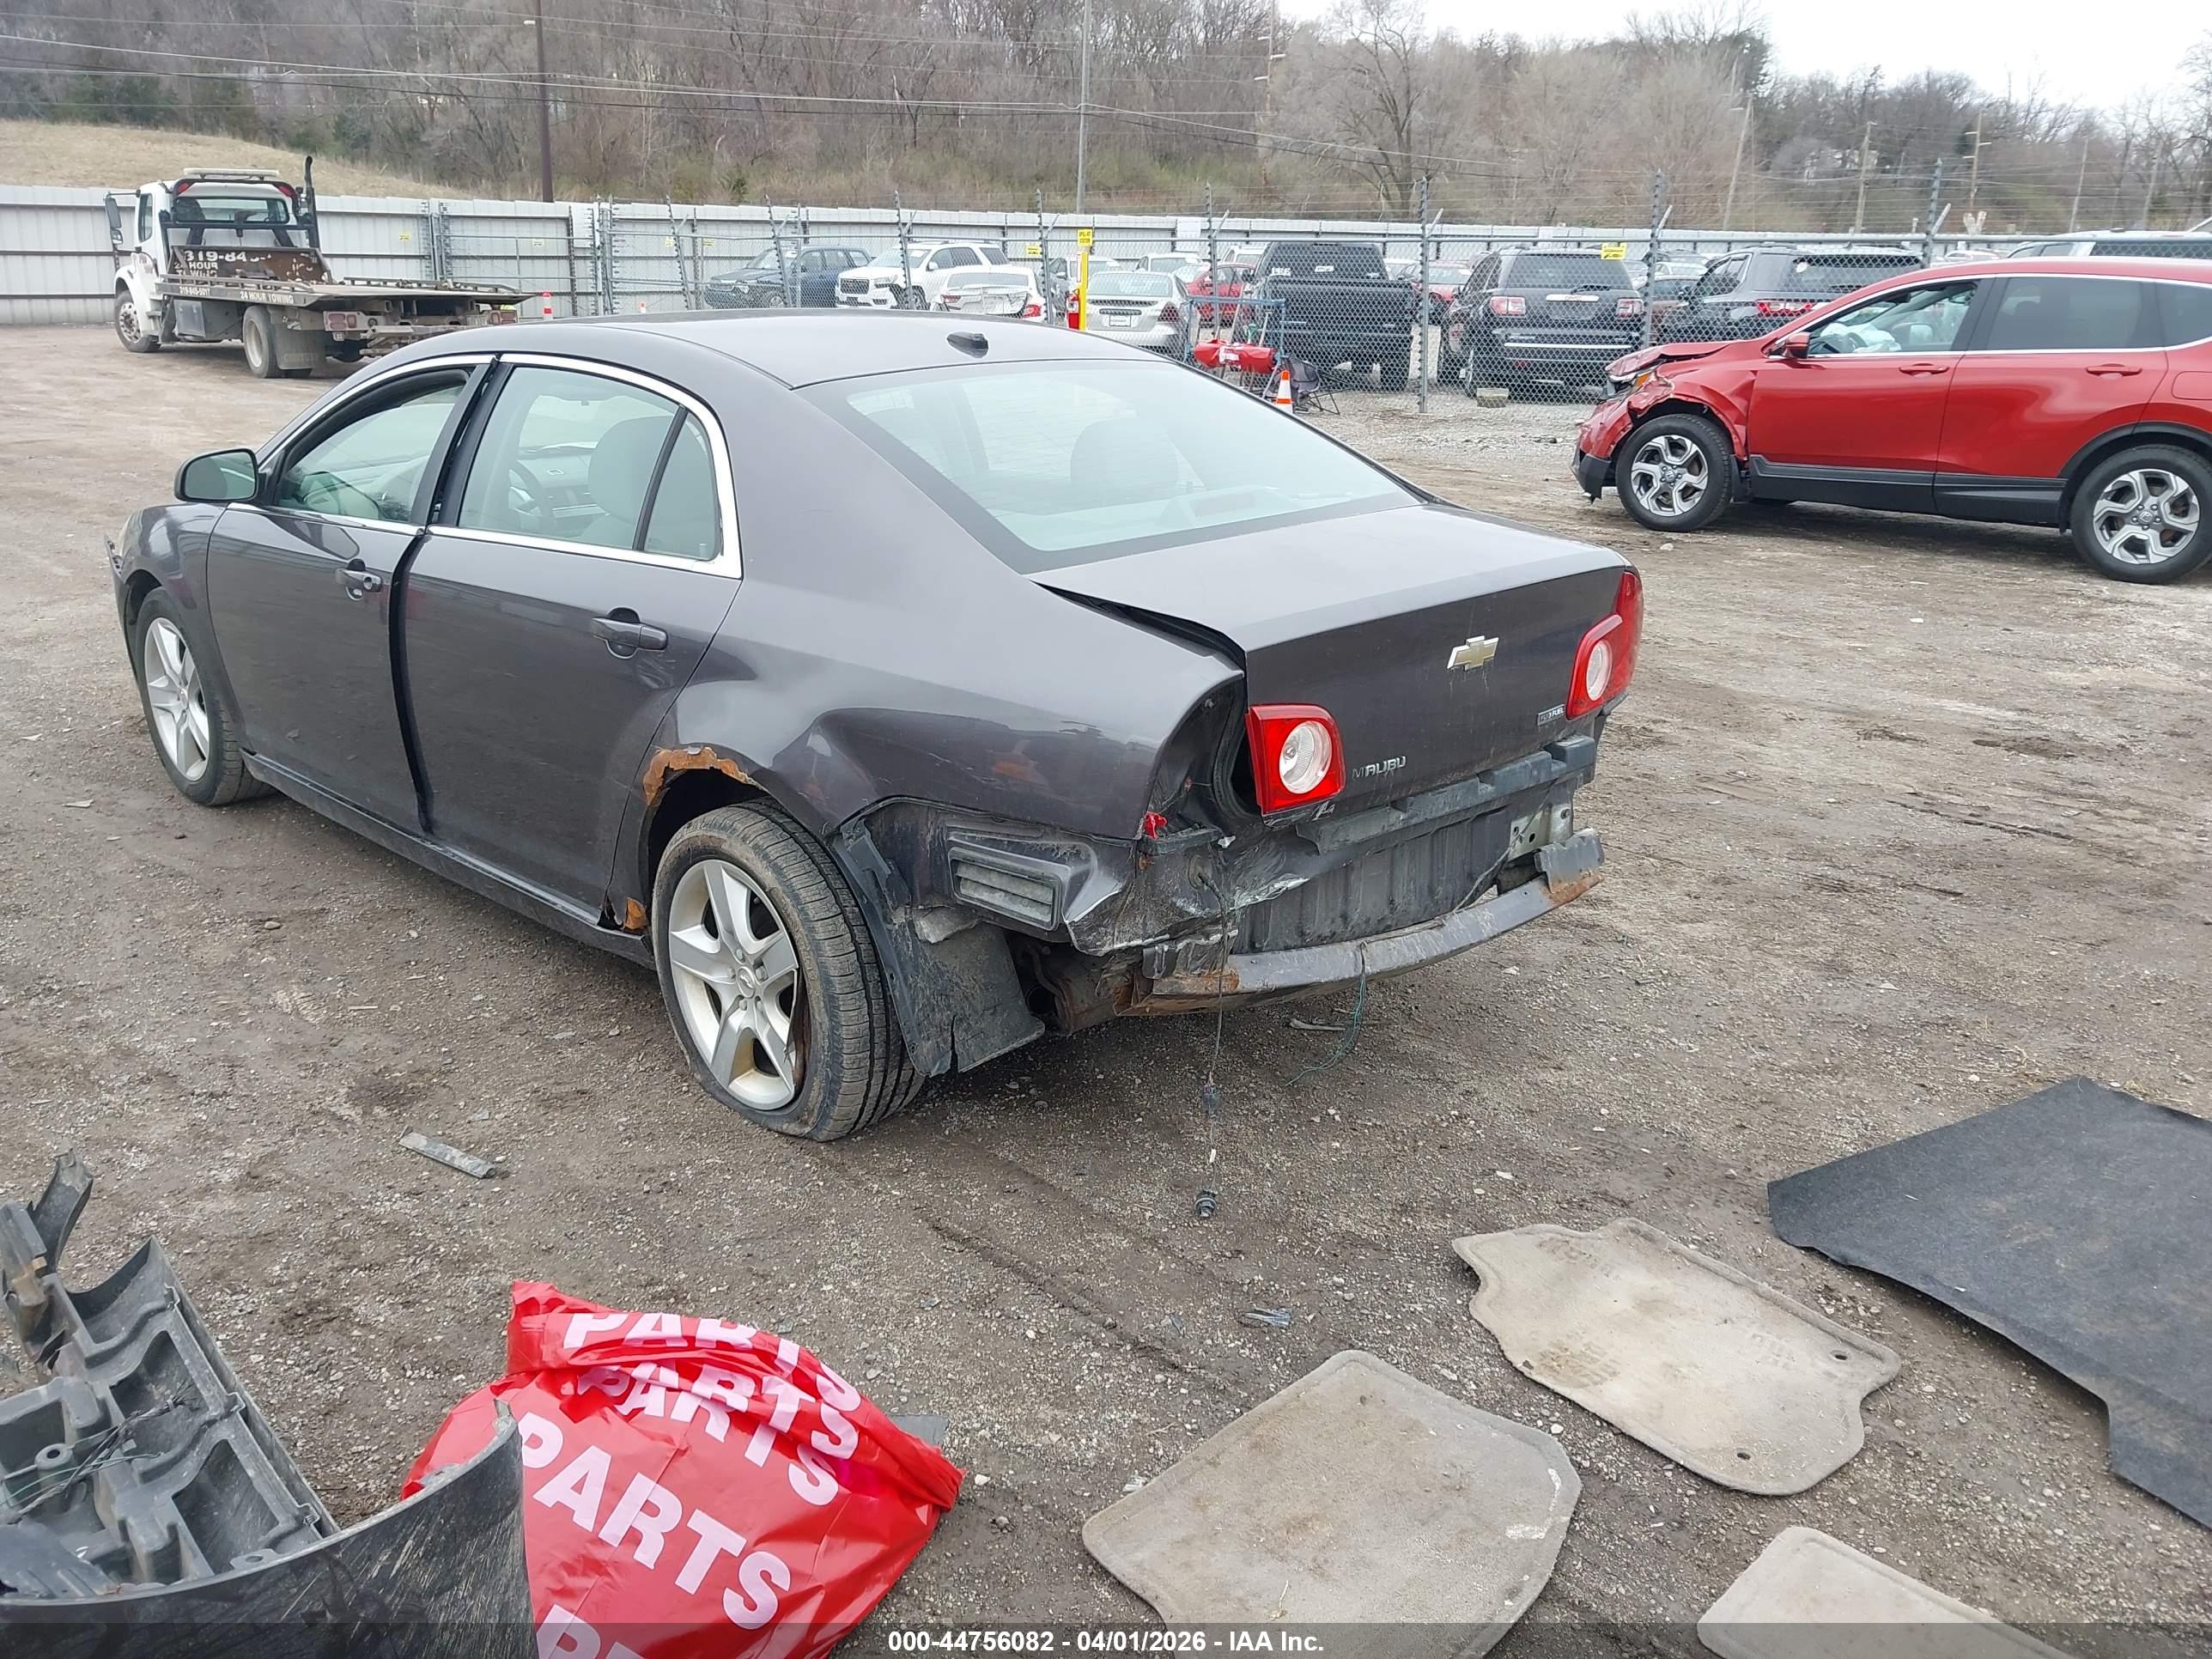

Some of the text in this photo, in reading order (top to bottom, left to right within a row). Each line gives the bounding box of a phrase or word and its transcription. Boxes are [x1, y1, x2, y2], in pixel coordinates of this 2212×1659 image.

[240, 291, 294, 304] 24 HOUR TOWING
[1352, 756, 1407, 781] MALIBU
[518, 1412, 791, 1629] PARTS
